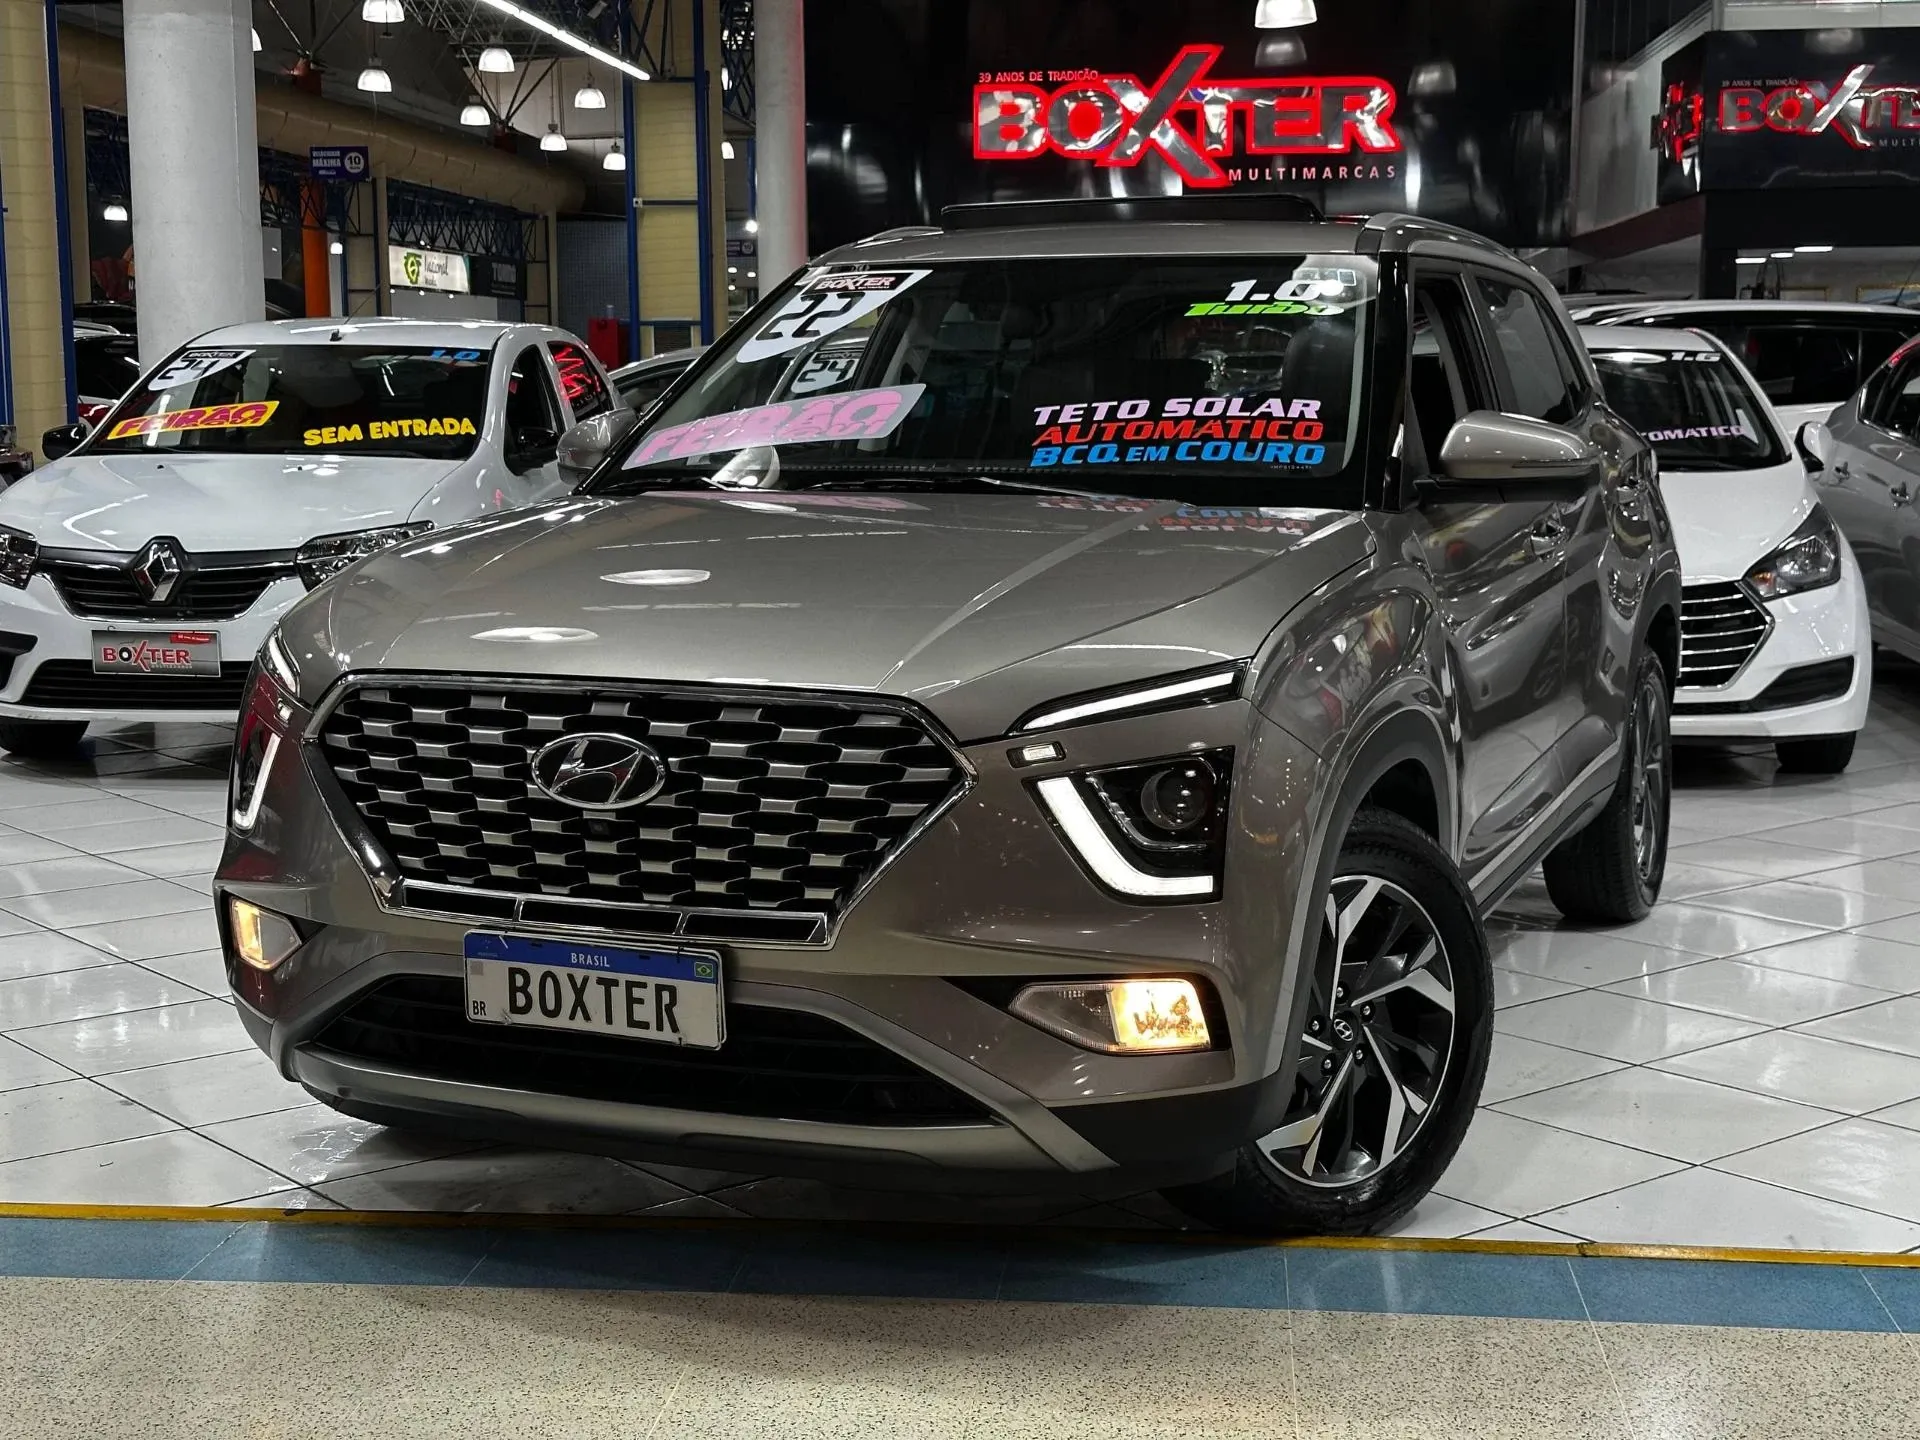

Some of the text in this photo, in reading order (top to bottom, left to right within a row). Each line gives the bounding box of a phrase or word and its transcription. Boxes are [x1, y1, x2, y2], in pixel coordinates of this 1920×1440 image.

[979, 73, 992, 83] 39
[996, 71, 1025, 82] ANOS
[1029, 71, 1044, 82] DE
[974, 43, 1400, 188] BOXTER
[346, 155, 361, 166] 10
[1228, 165, 1396, 182] MULTIMARCAS
[814, 275, 896, 290] BOXTER
[755, 291, 866, 341] 22
[1033, 398, 1321, 425] TETO SOLAR
[303, 417, 477, 446] SEM ENTRADA
[1125, 446, 1169, 462] EM
[1175, 441, 1325, 465] COURO
[102, 639, 192, 672] BOXTER
[570, 952, 610, 968] BRASIL
[472, 1000, 487, 1017] BR
[508, 967, 680, 1034] BOXTER
